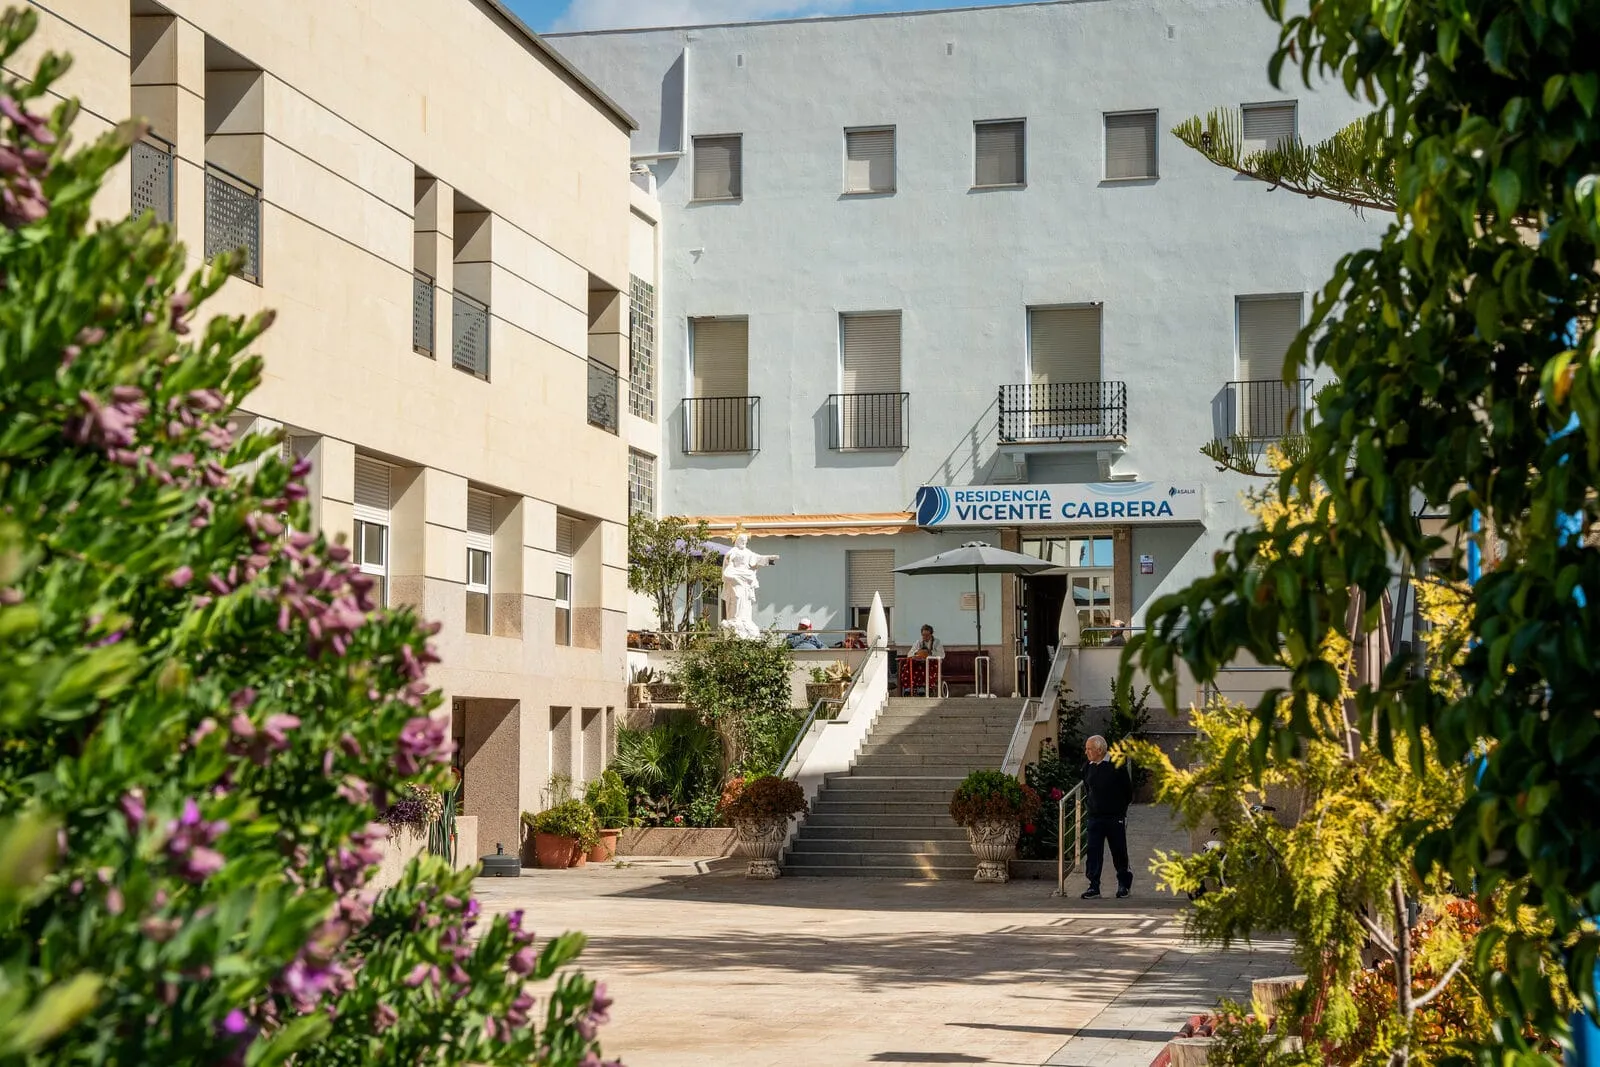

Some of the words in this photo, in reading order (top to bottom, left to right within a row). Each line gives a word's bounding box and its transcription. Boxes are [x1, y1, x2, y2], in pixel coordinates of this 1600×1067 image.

[955, 489, 1051, 503] RESIDENCIA
[956, 503, 1052, 520] VICENTE
[1061, 500, 1173, 519] CABRERA
